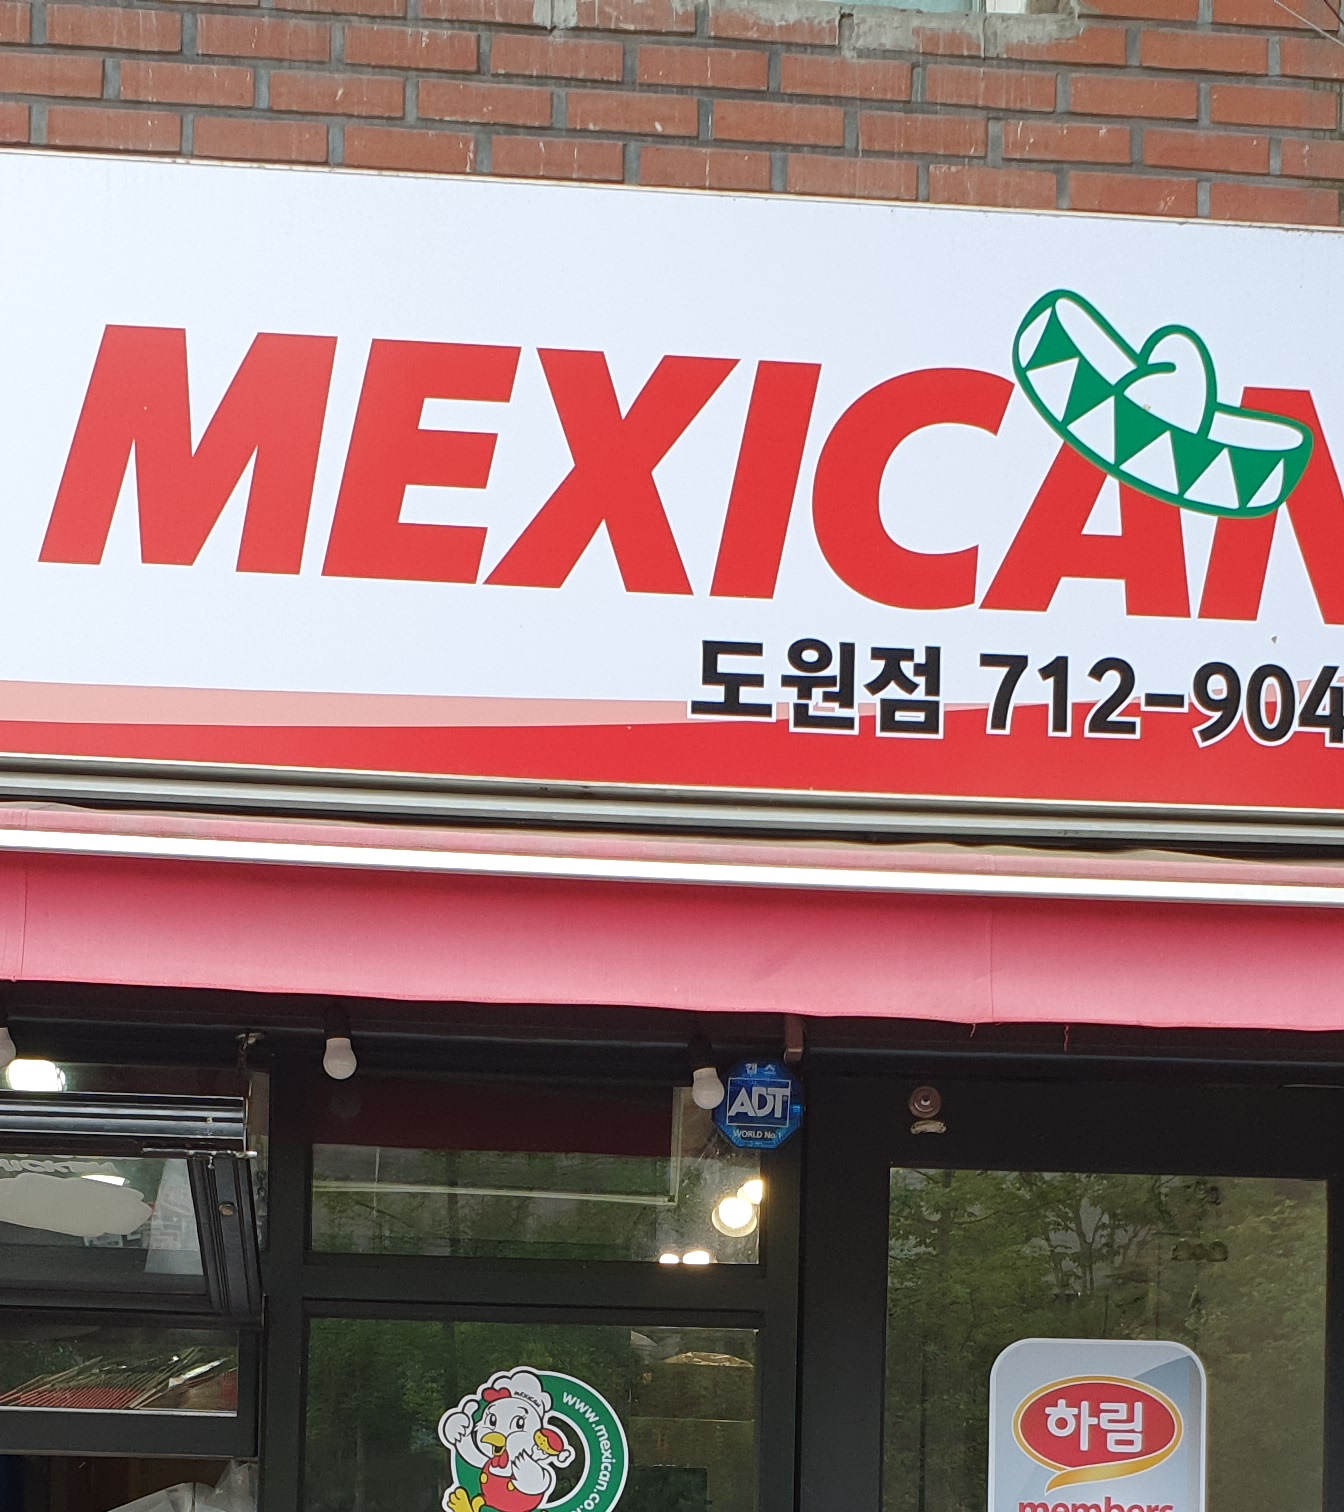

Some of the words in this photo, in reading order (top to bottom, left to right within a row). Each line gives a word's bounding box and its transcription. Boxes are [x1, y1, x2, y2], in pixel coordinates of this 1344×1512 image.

[689, 637, 945, 738] 도원점
[729, 1086, 790, 1119] ADT
[1044, 1399, 1144, 1453] 하림
